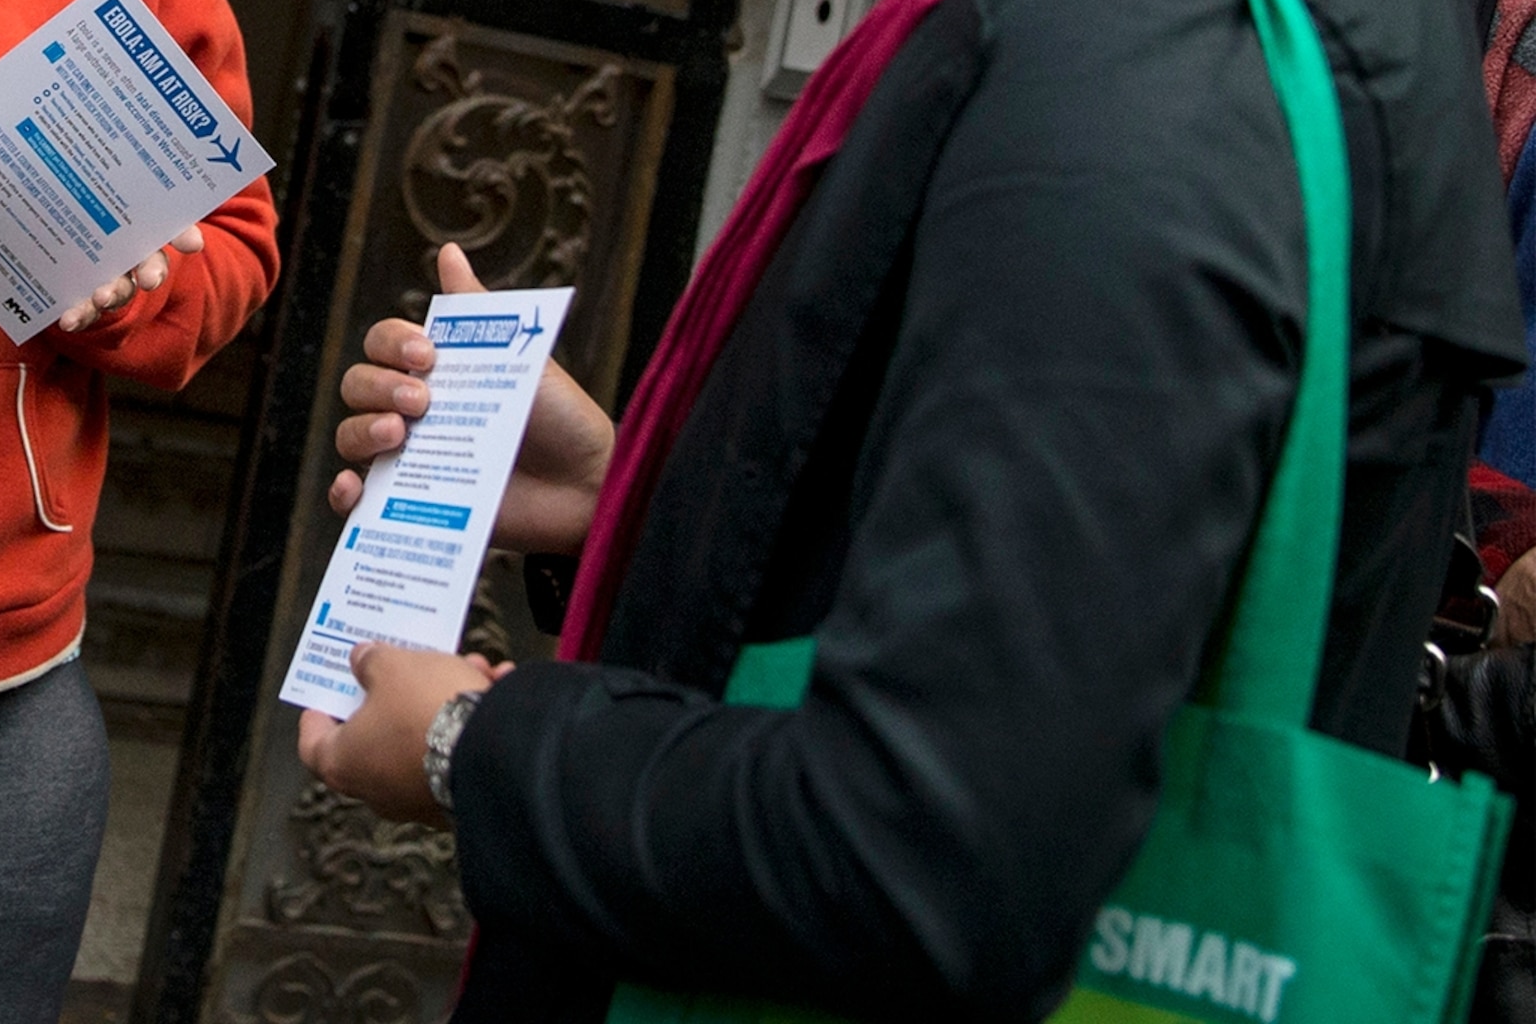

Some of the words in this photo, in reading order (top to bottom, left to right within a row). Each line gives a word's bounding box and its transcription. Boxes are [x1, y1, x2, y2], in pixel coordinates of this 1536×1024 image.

[102, 4, 148, 54] EBOLA:
[75, 19, 96, 40] Ebola
[90, 37, 101, 48] is
[134, 91, 153, 111] fatal
[148, 108, 174, 137] disease
[135, 46, 164, 74] AM
[152, 66, 170, 81] I
[157, 73, 183, 97] AT
[112, 85, 127, 101] now
[122, 98, 155, 135] occurring
[150, 131, 162, 142] in
[156, 138, 177, 160] West
[170, 88, 212, 132] RISK?
[4, 296, 30, 324] NYC
[1090, 907, 1296, 1024] SMART
